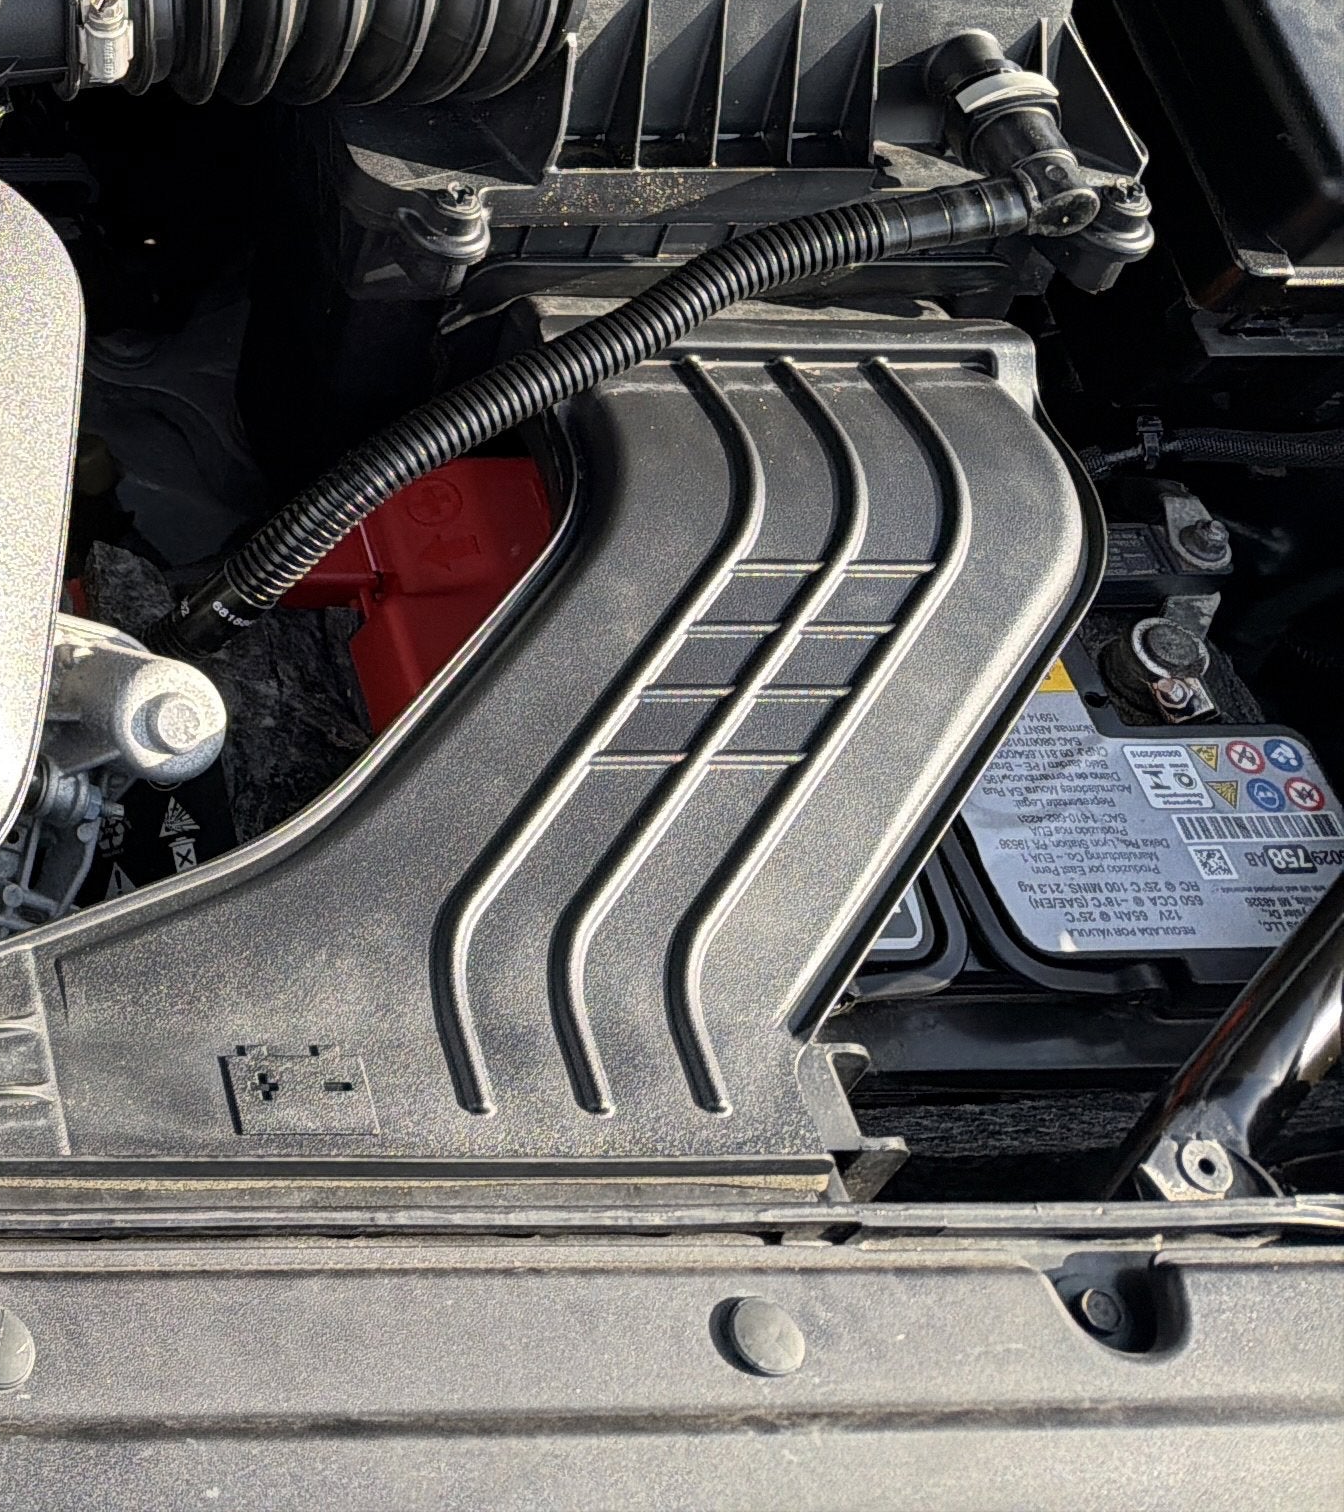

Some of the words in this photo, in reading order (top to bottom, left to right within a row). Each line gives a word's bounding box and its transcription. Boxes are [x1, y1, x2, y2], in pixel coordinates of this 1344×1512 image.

[1024, 785, 1059, 795] Moura
[1029, 826, 1053, 836] EUA
[1031, 865, 1059, 875] Penn
[1062, 865, 1086, 875] East
[1018, 881, 1037, 894] kg
[1104, 881, 1125, 893] 100
[1179, 881, 1200, 892] RC
[1147, 895, 1178, 907] CCA
[1180, 895, 1204, 906] 650
[1113, 910, 1148, 922] 65Ah
[1159, 909, 1182, 921] 12V
[1114, 926, 1138, 936] POR
[1139, 926, 1196, 936] REGULADA
